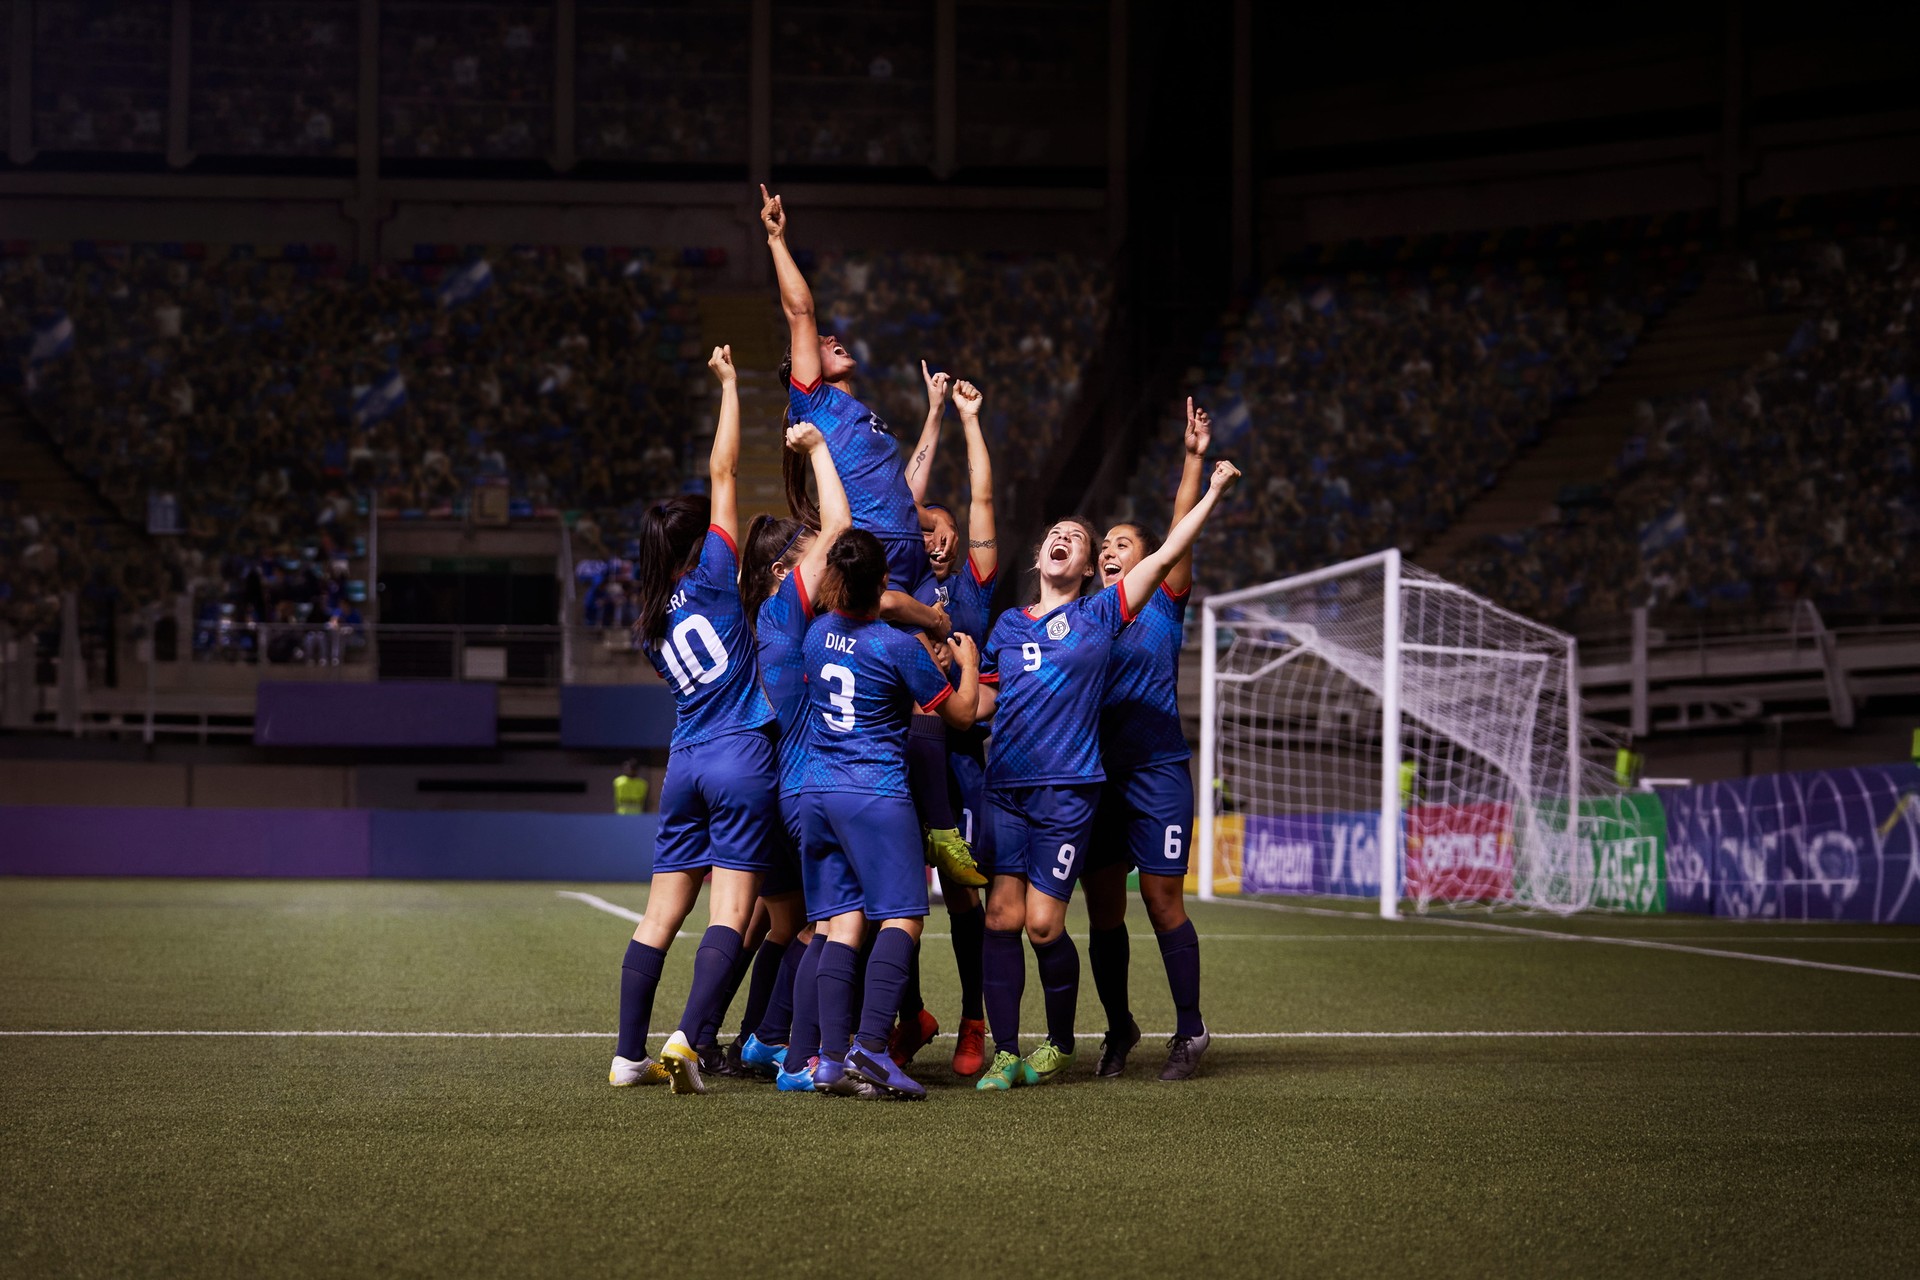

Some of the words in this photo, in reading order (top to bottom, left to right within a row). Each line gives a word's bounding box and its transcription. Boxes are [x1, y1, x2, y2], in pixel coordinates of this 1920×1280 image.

[653, 613, 729, 697] 10
[825, 632, 858, 655] DIAZ
[1021, 642, 1043, 672] 9
[820, 662, 856, 733] 3
[1164, 824, 1183, 860] 6
[1052, 842, 1076, 881] 9
